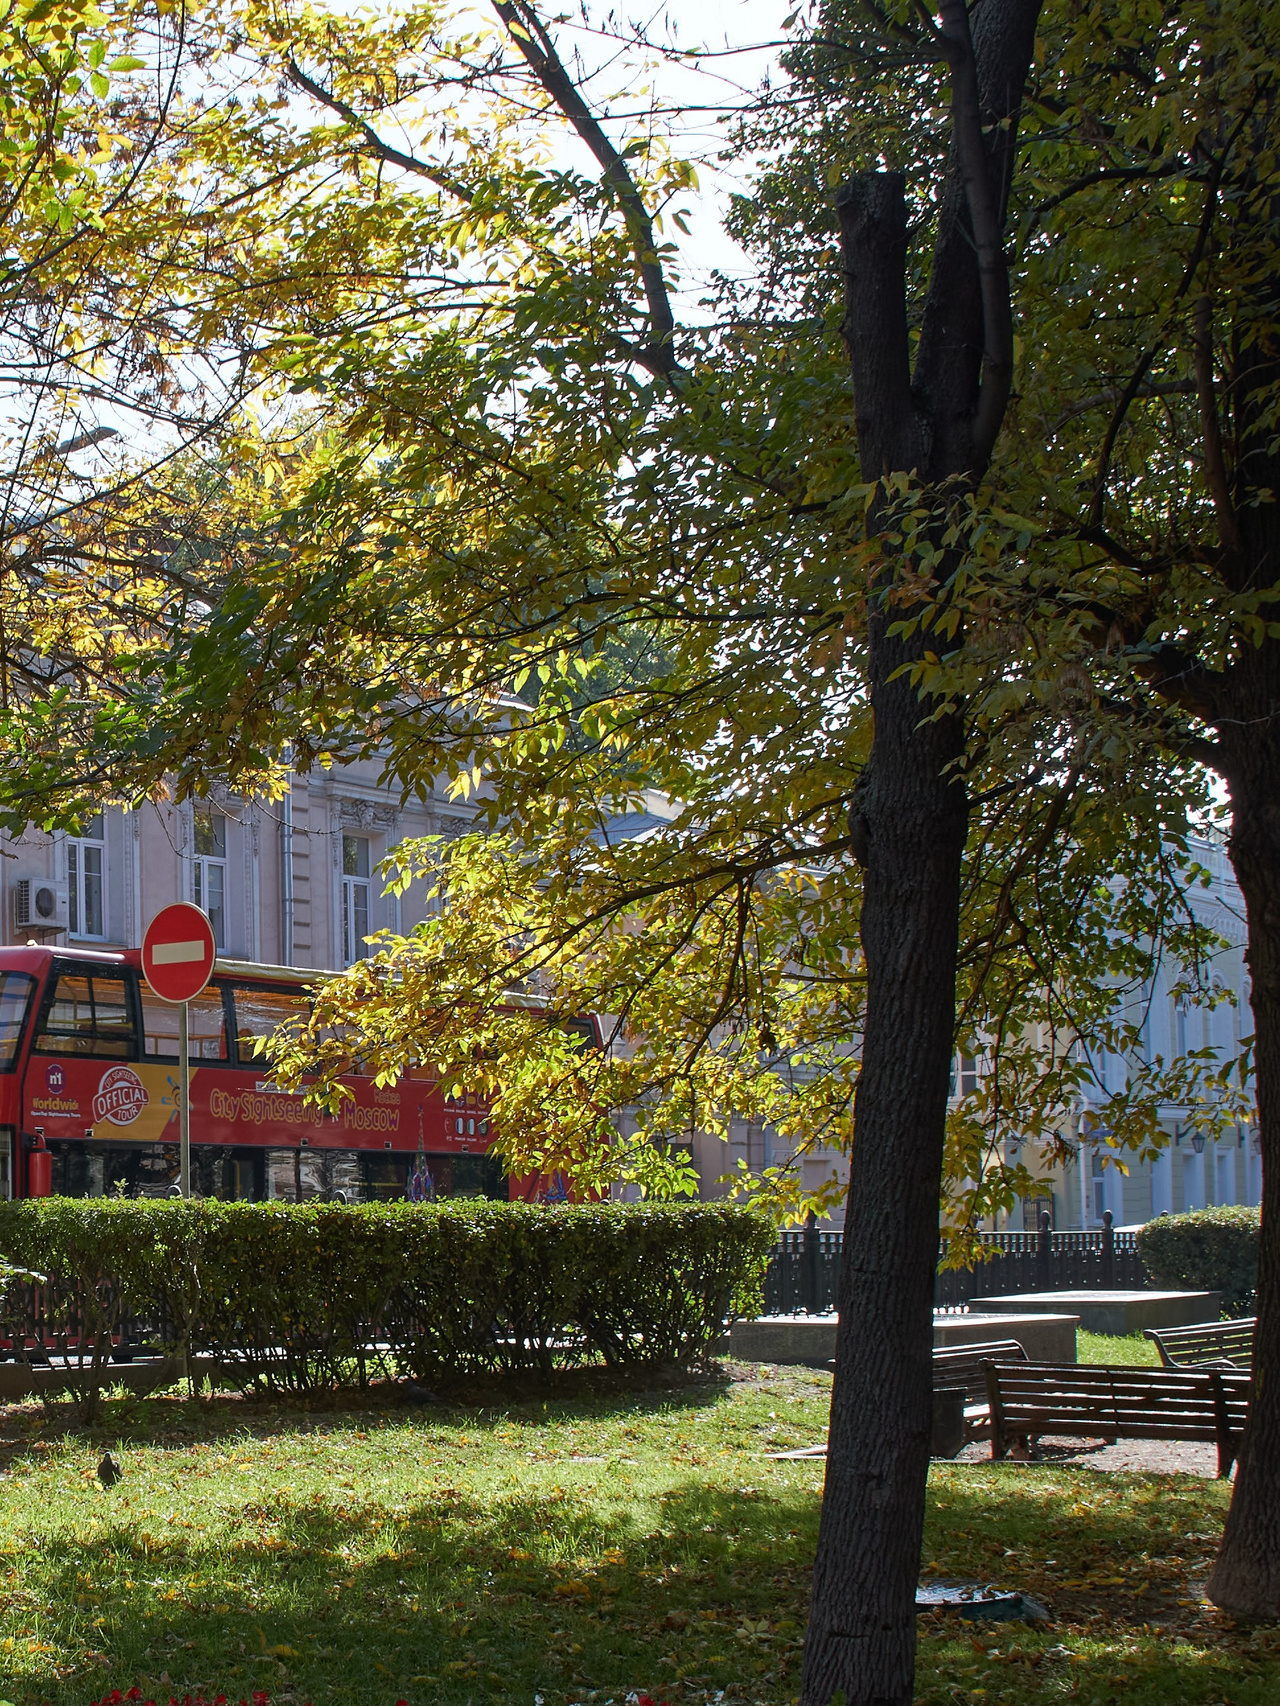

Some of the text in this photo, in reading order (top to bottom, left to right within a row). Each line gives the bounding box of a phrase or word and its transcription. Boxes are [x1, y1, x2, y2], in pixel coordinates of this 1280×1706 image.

[97, 1088, 148, 1115] OFFICIAL
[117, 1105, 139, 1121] TOUR
[210, 1088, 240, 1122] City
[241, 1092, 324, 1128] Sightseeing
[344, 1099, 400, 1132] Moscow
